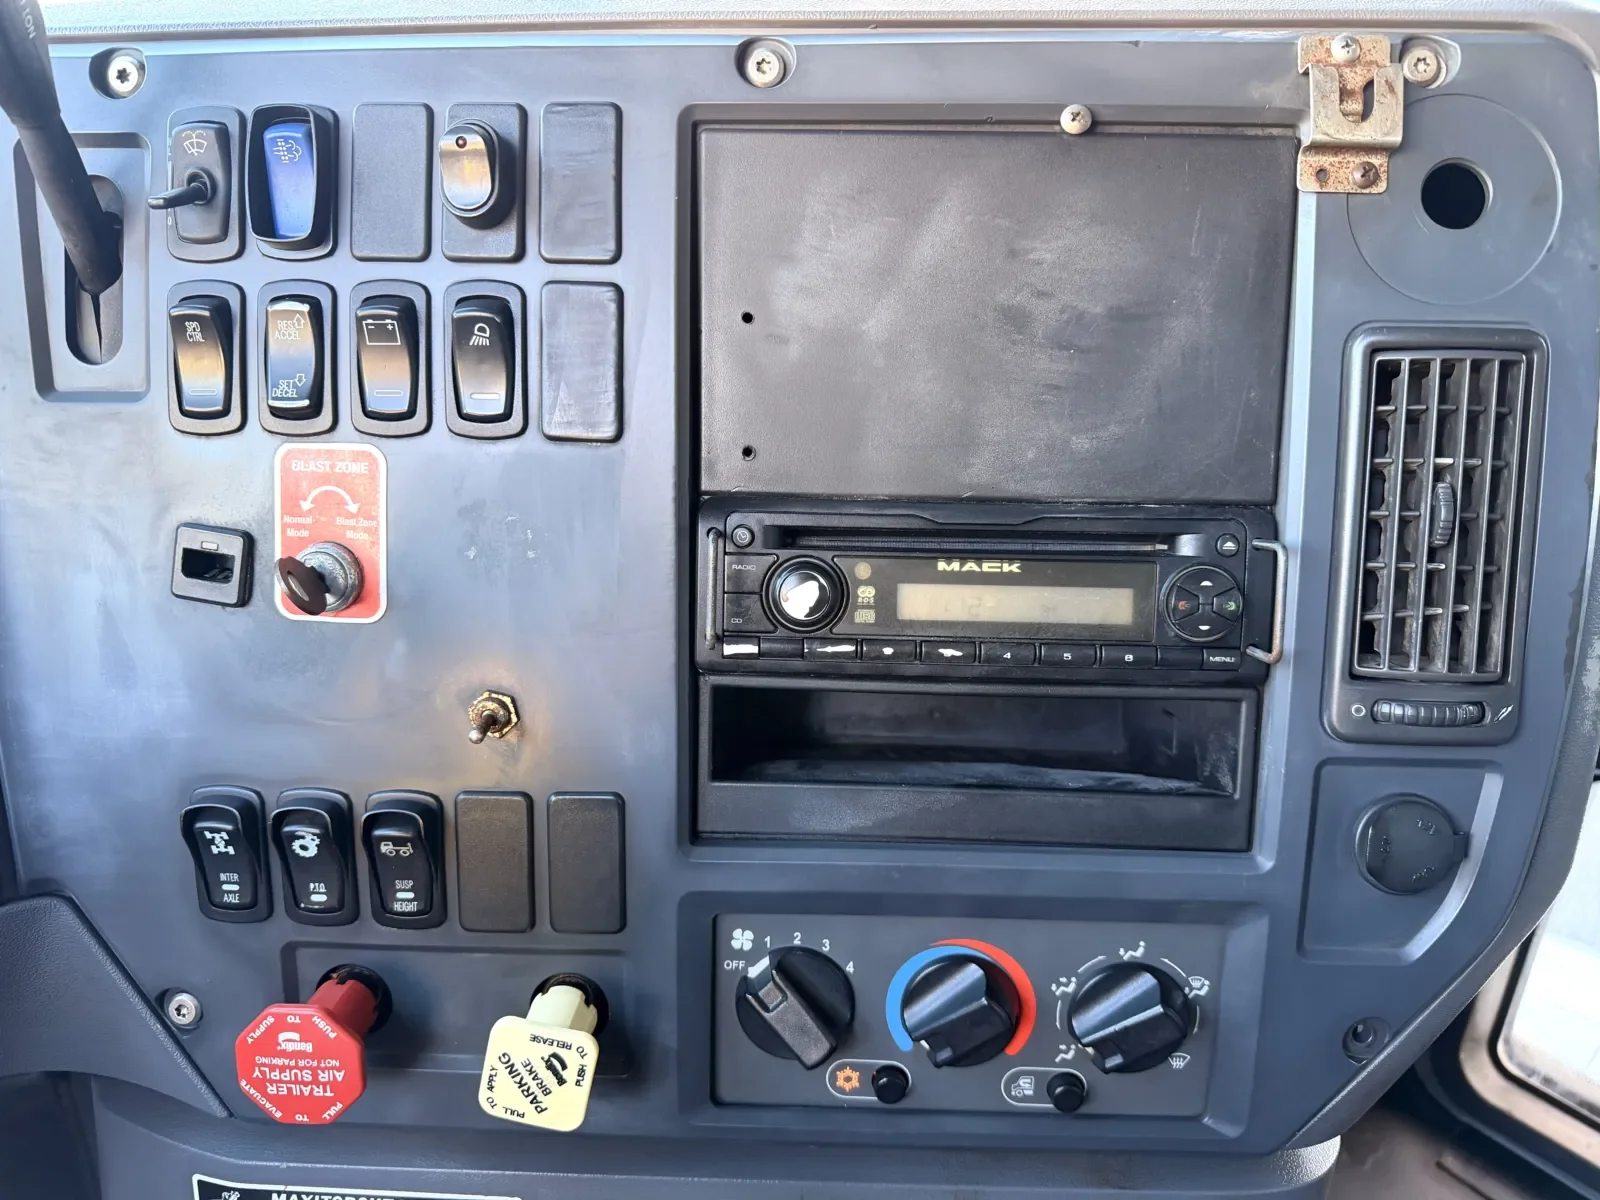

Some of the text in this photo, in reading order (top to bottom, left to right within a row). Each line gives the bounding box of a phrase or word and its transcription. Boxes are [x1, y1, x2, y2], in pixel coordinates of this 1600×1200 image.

[185, 321, 200, 332] SPD
[186, 331, 205, 342] CTRL
[274, 330, 301, 340] ACCEL
[278, 379, 294, 390] SET
[272, 388, 298, 398] DECEL
[291, 460, 369, 474] BLAST ZONE
[283, 514, 313, 524] Normal
[336, 516, 378, 527] Blast Zone
[286, 527, 310, 538] Mode
[345, 530, 369, 541] Mode
[937, 558, 1022, 573] MACK
[1002, 652, 1012, 660] 4
[1063, 653, 1072, 661] 5
[219, 872, 240, 883] INTER
[395, 879, 414, 890] SUSP
[223, 893, 240, 903] AXLE
[394, 901, 418, 913] HEIGHT
[764, 935, 771, 949] 1
[793, 932, 802, 945] 2
[821, 938, 831, 952] 3
[723, 959, 746, 971] OFF
[845, 960, 855, 975] 4
[245, 1014, 338, 1045] PUSH TO SUPPLY
[254, 1056, 340, 1067] NOT FOR PARKING
[528, 1033, 589, 1087] PUSH TO RELEASE
[251, 1066, 346, 1082] AIR SUPPLY
[520, 1057, 553, 1097] BRAKE
[497, 1051, 549, 1115] PARKING
[265, 1082, 335, 1097] TRAILER
[486, 1064, 526, 1119] PULL TO APPLY
[239, 1078, 344, 1122] PULL TO EVACUATE
